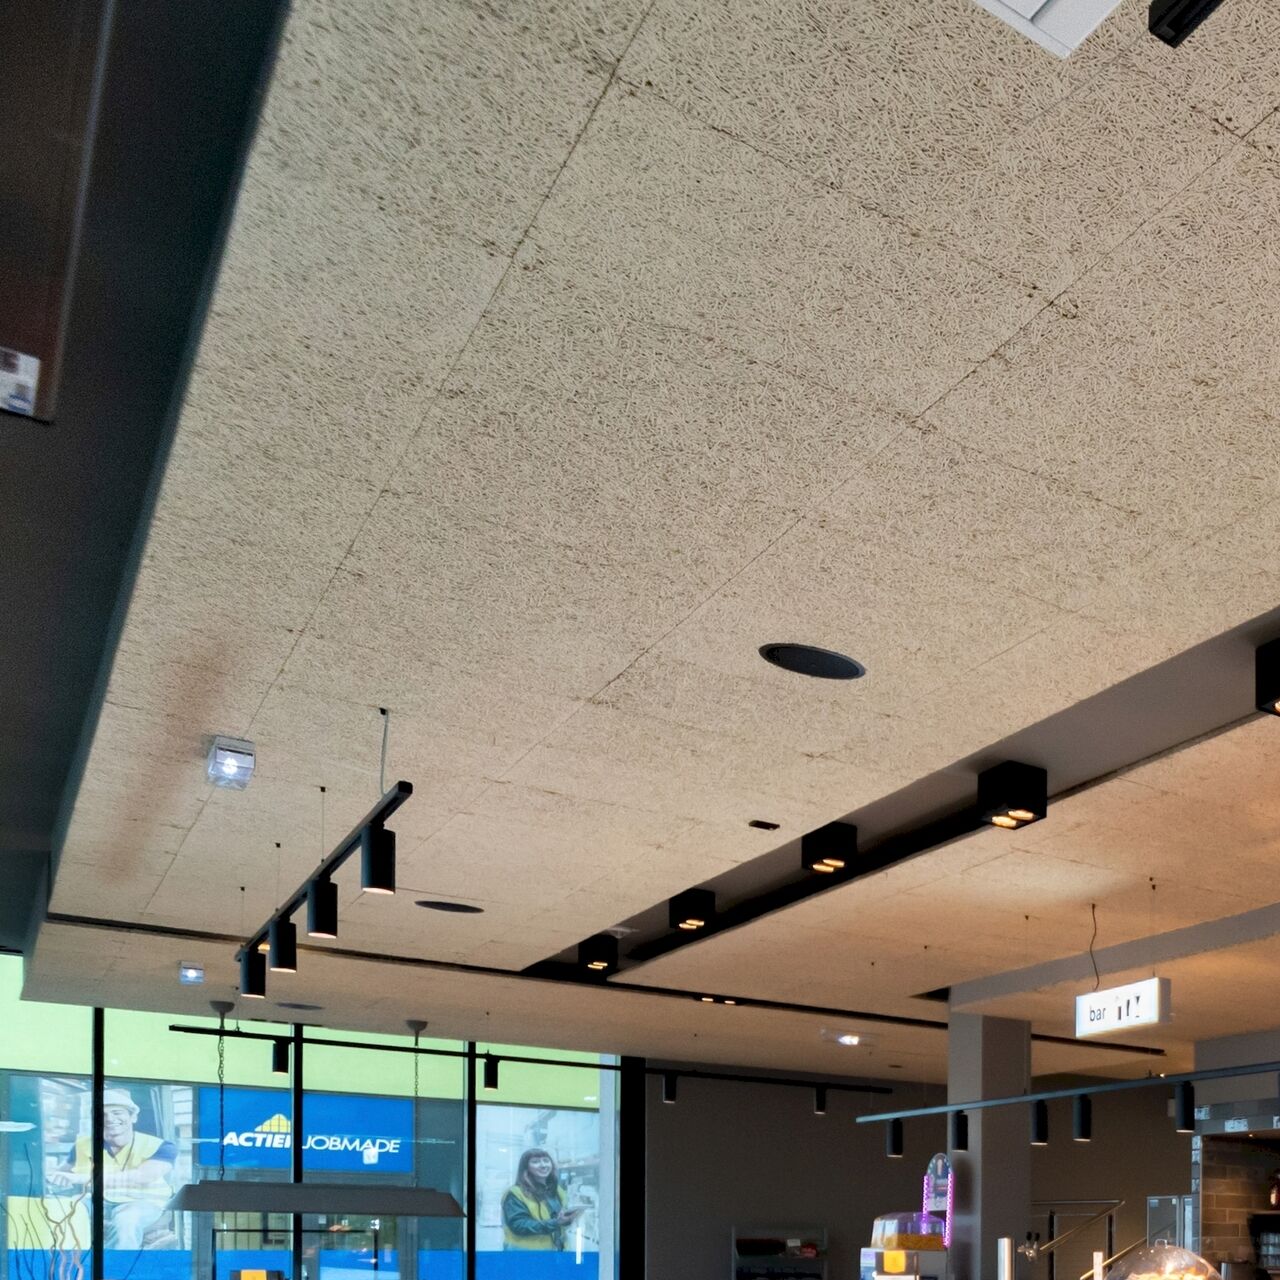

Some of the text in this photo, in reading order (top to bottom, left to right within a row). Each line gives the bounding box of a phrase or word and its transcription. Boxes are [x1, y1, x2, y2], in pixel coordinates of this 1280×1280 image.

[1088, 1005, 1106, 1021] bar
[222, 1131, 401, 1154] ACTIE JOBMADE
